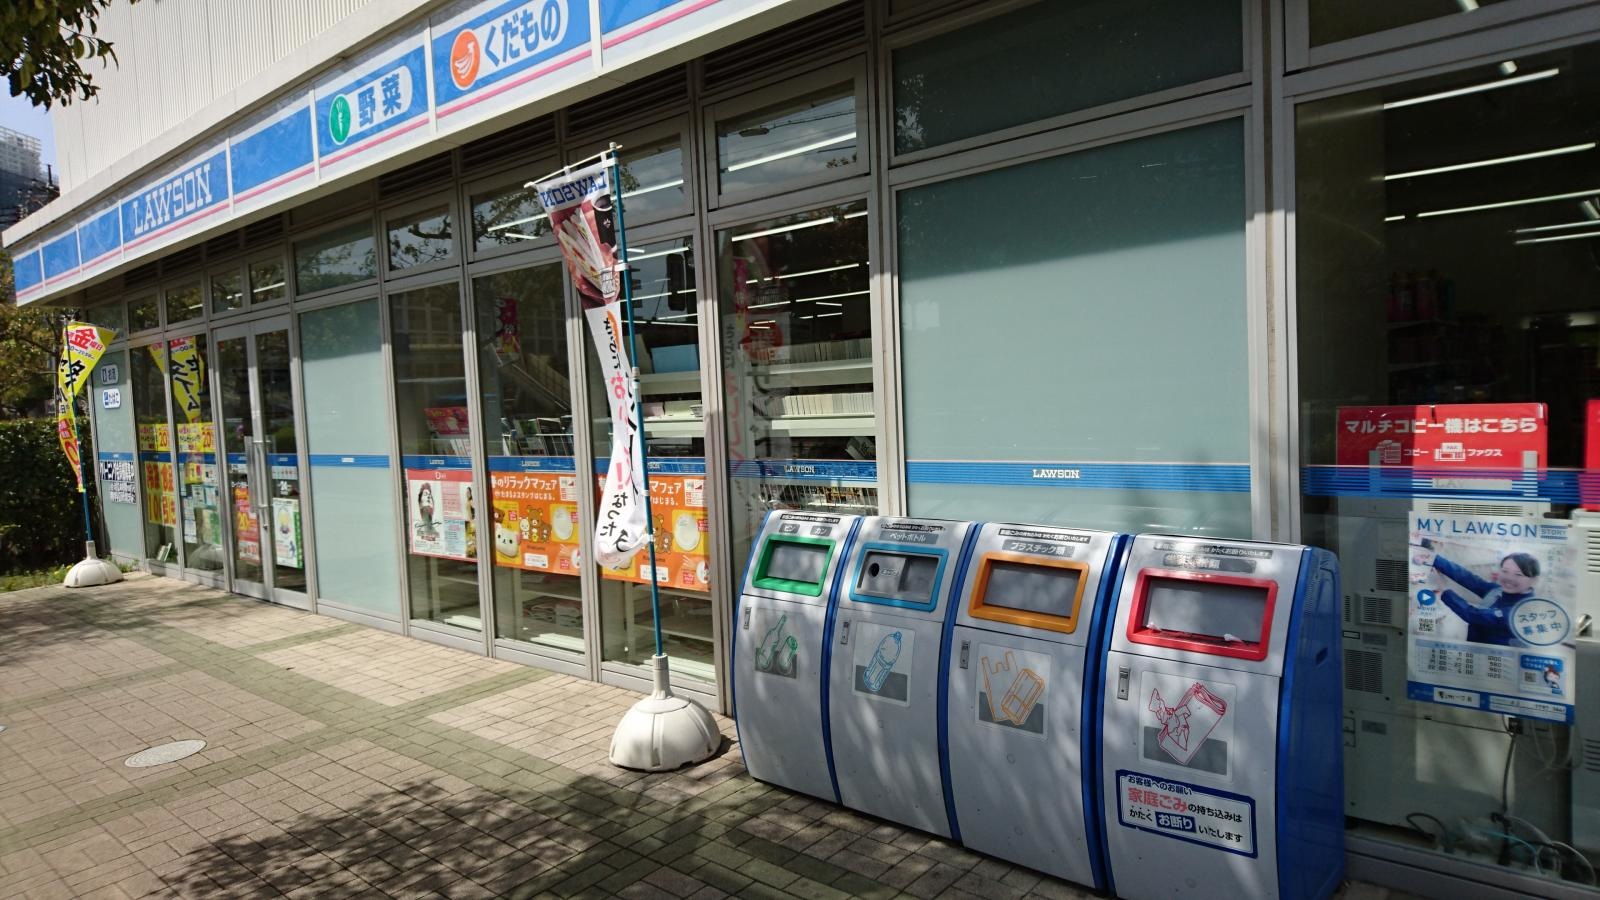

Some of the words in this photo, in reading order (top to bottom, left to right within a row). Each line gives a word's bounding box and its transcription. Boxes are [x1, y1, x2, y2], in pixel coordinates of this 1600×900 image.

[485, 0, 560, 68] くだもの
[357, 74, 402, 127] 野菜
[132, 163, 213, 236] LAWSON
[1345, 417, 1538, 434] マルチコピー機はこちら
[1404, 448, 1429, 457] コピー
[1467, 448, 1503, 457] ファクス
[784, 464, 815, 474] LAWSON
[1032, 469, 1080, 479] LAWSON
[649, 480, 681, 494] マフェア
[1417, 518, 1444, 532] MY
[1452, 520, 1537, 538] LAWSON
[1541, 528, 1567, 536] STORY
[889, 532, 927, 542] ペットボトル
[1010, 542, 1066, 555] プラスチック類
[1518, 610, 1557, 624] スタッフ
[1523, 621, 1562, 636] 募集中
[1128, 775, 1193, 796] お客様へのお願い
[1128, 787, 1243, 823] 家庭ごみの持ち込みは
[1129, 808, 1153, 822] かたく
[1158, 813, 1193, 829] お断り
[1199, 825, 1243, 843] いたします
